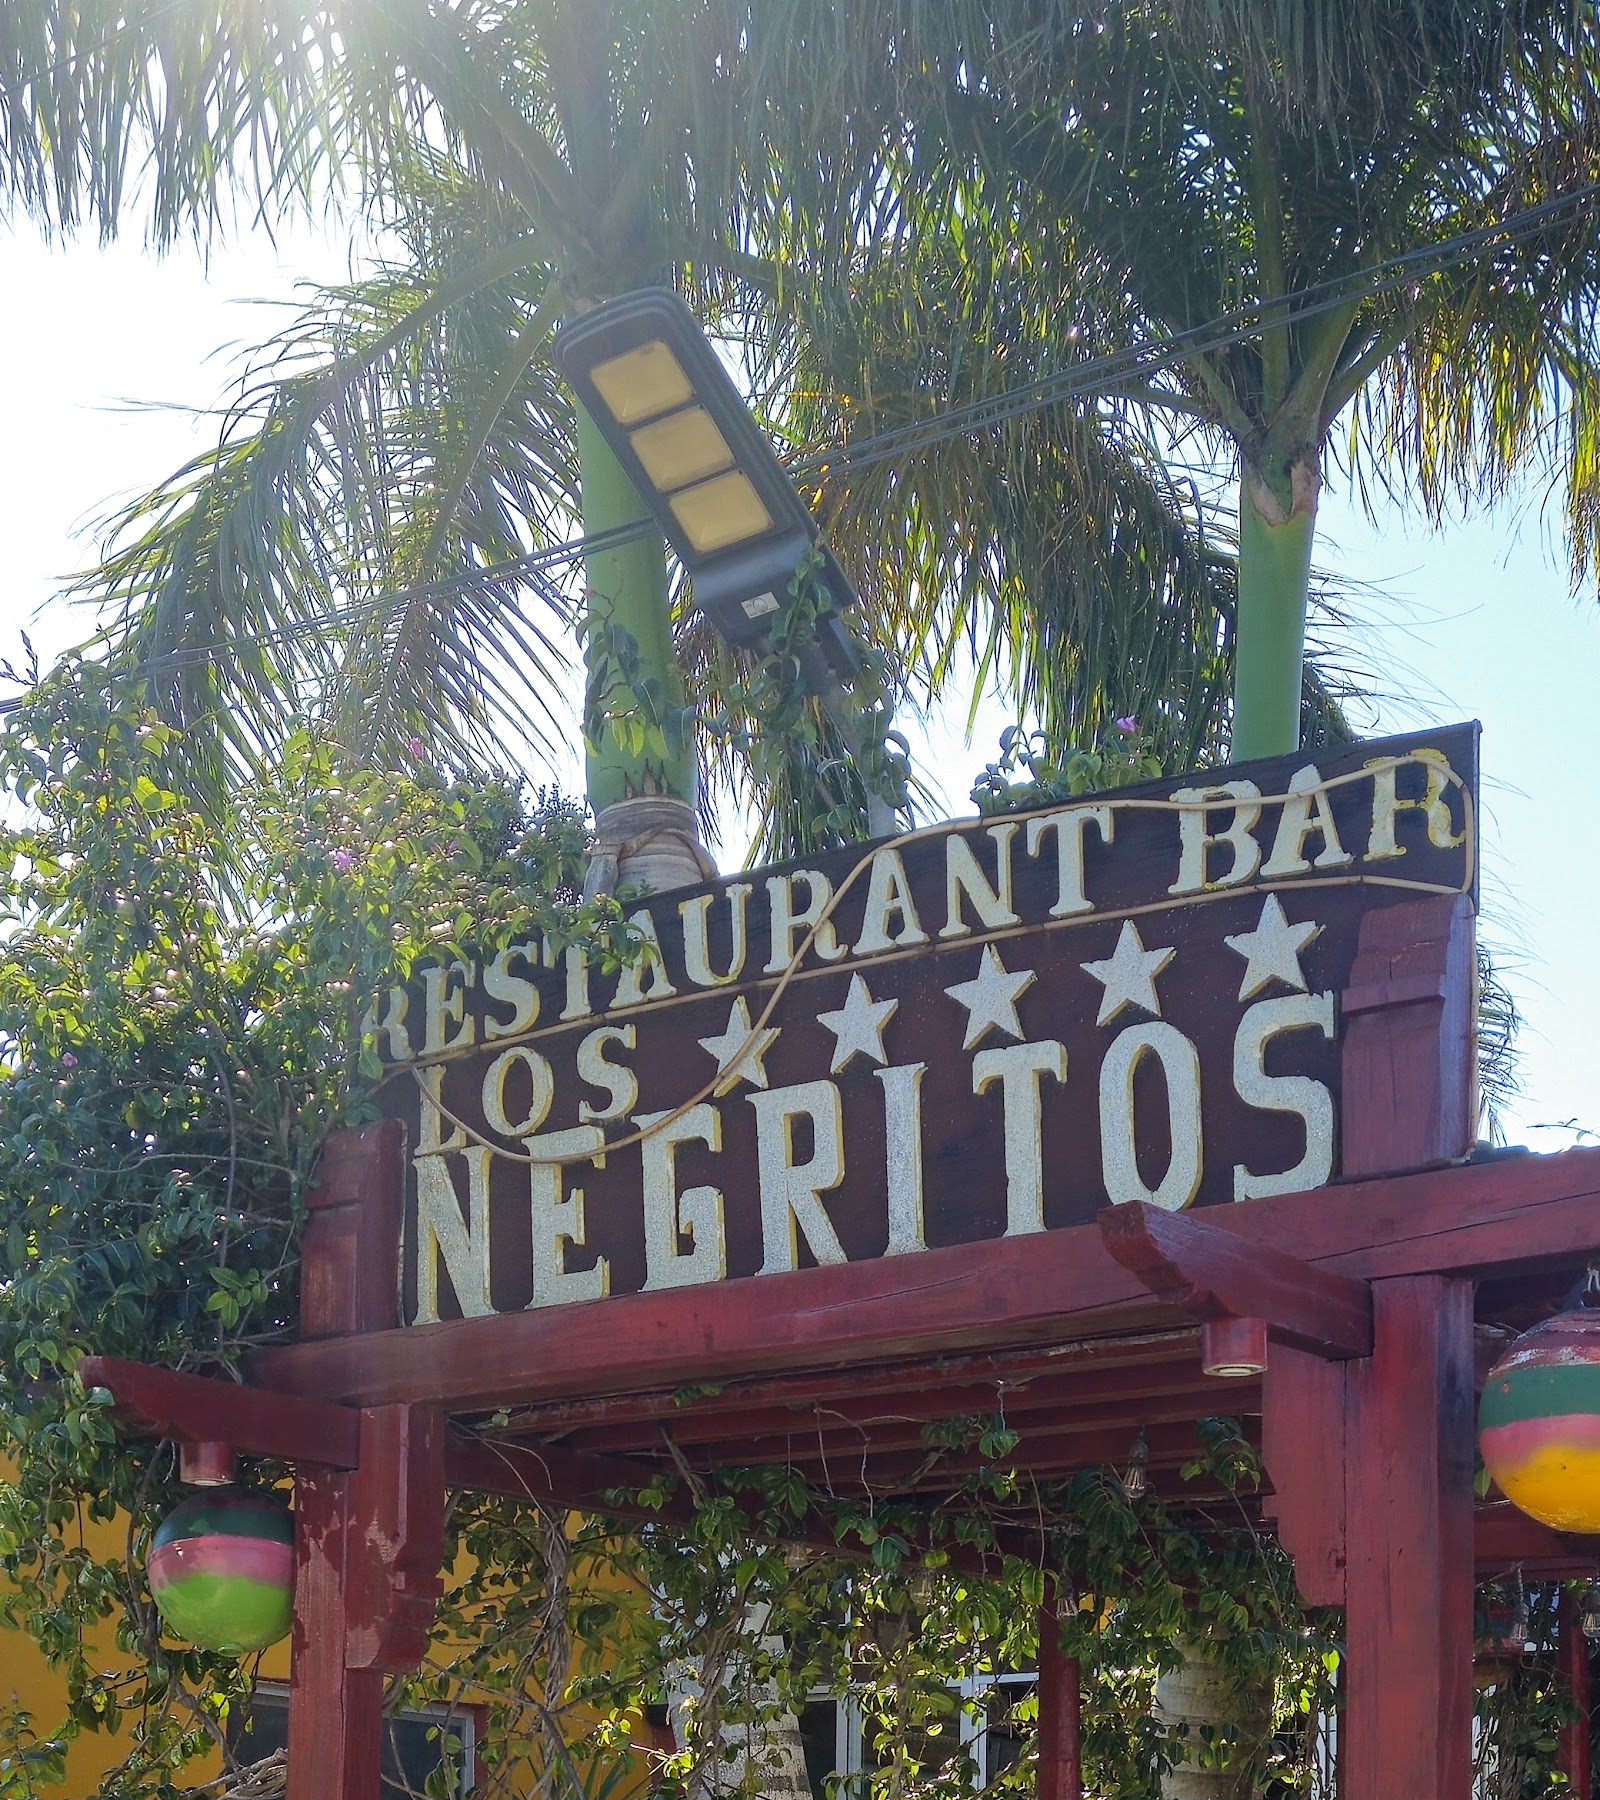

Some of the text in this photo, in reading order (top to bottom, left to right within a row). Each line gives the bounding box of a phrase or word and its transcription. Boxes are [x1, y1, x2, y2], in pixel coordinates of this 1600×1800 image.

[1167, 748, 1466, 893] BAR
[412, 989, 1335, 1327] NEGRITOS
[414, 1023, 638, 1157] LOS
